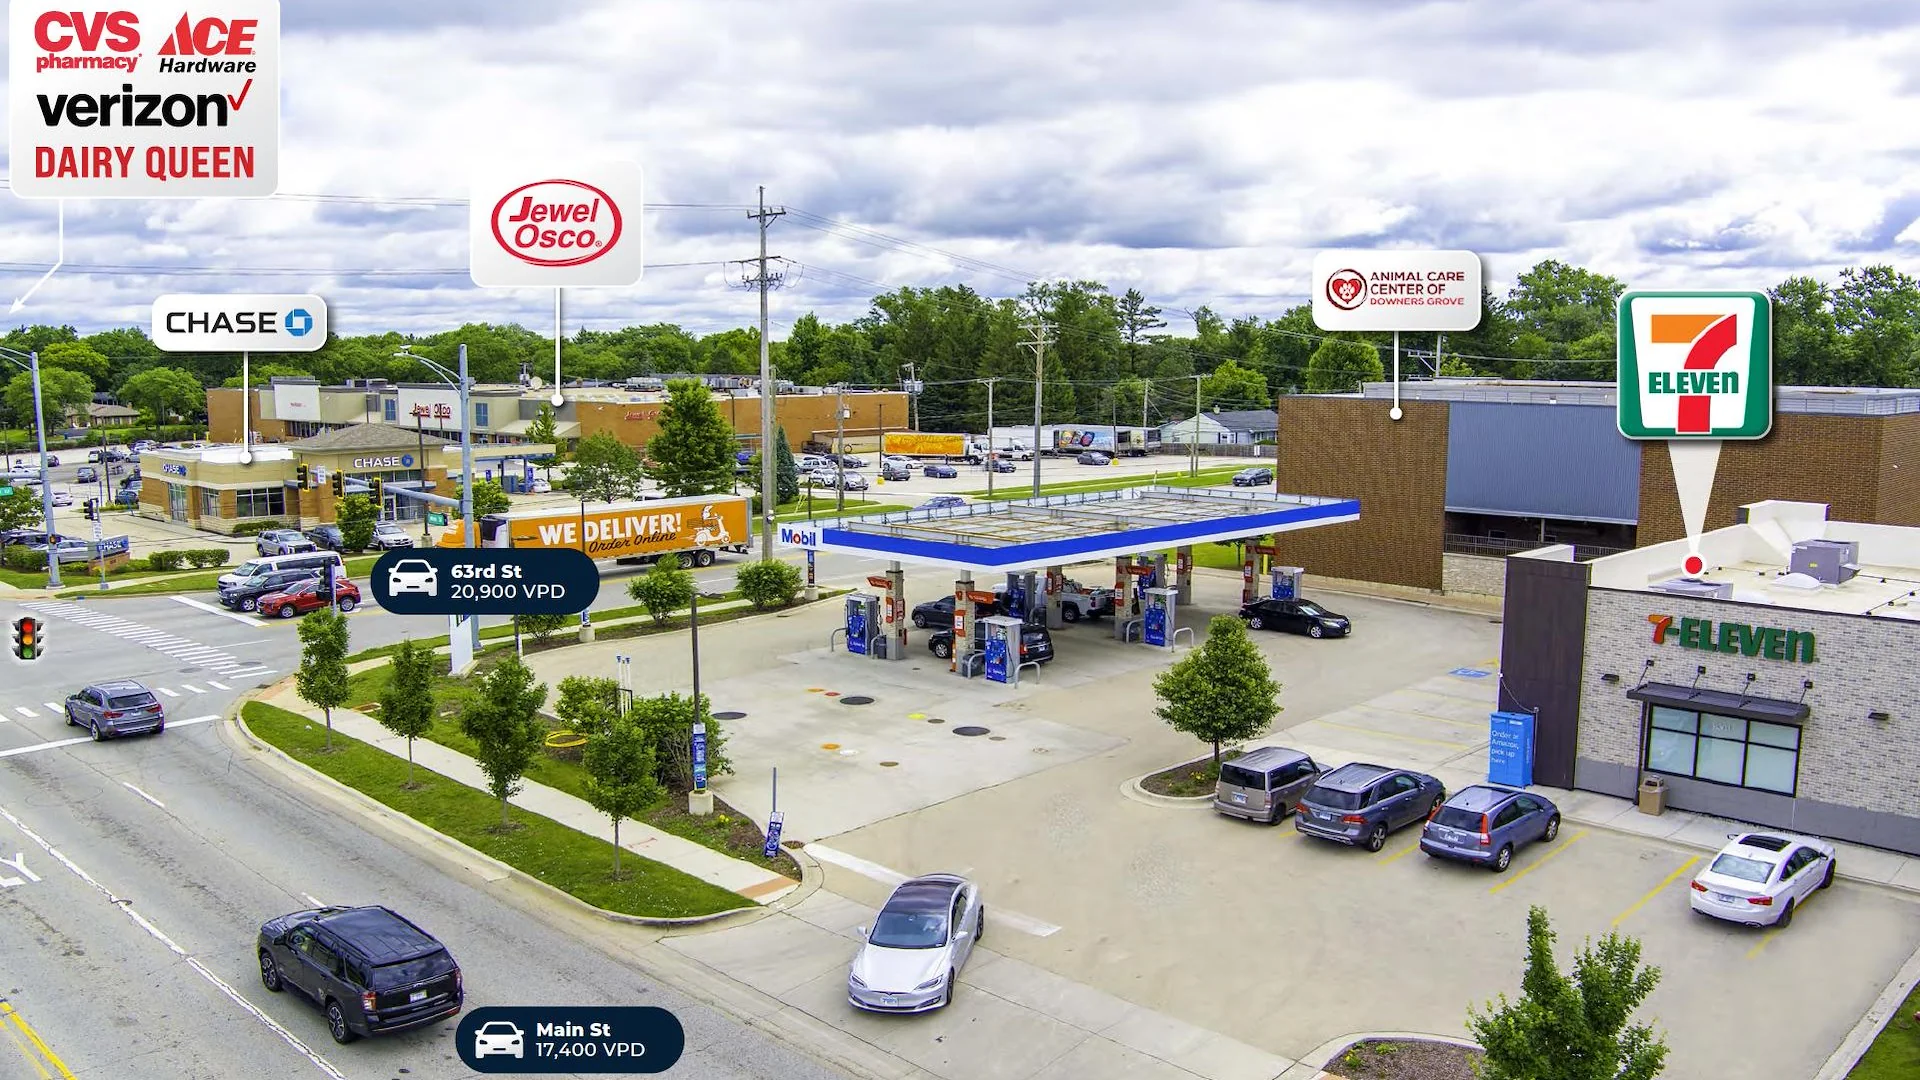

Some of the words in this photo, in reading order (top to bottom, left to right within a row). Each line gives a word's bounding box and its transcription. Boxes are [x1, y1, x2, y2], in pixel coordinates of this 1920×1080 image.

[163, 463, 180, 474] CHASE
[354, 456, 400, 468] CHASE
[538, 523, 577, 546] WE
[583, 513, 681, 542] DELIVER!
[781, 528, 816, 546] Mobil
[589, 540, 631, 553] Order
[633, 532, 676, 546] Online
